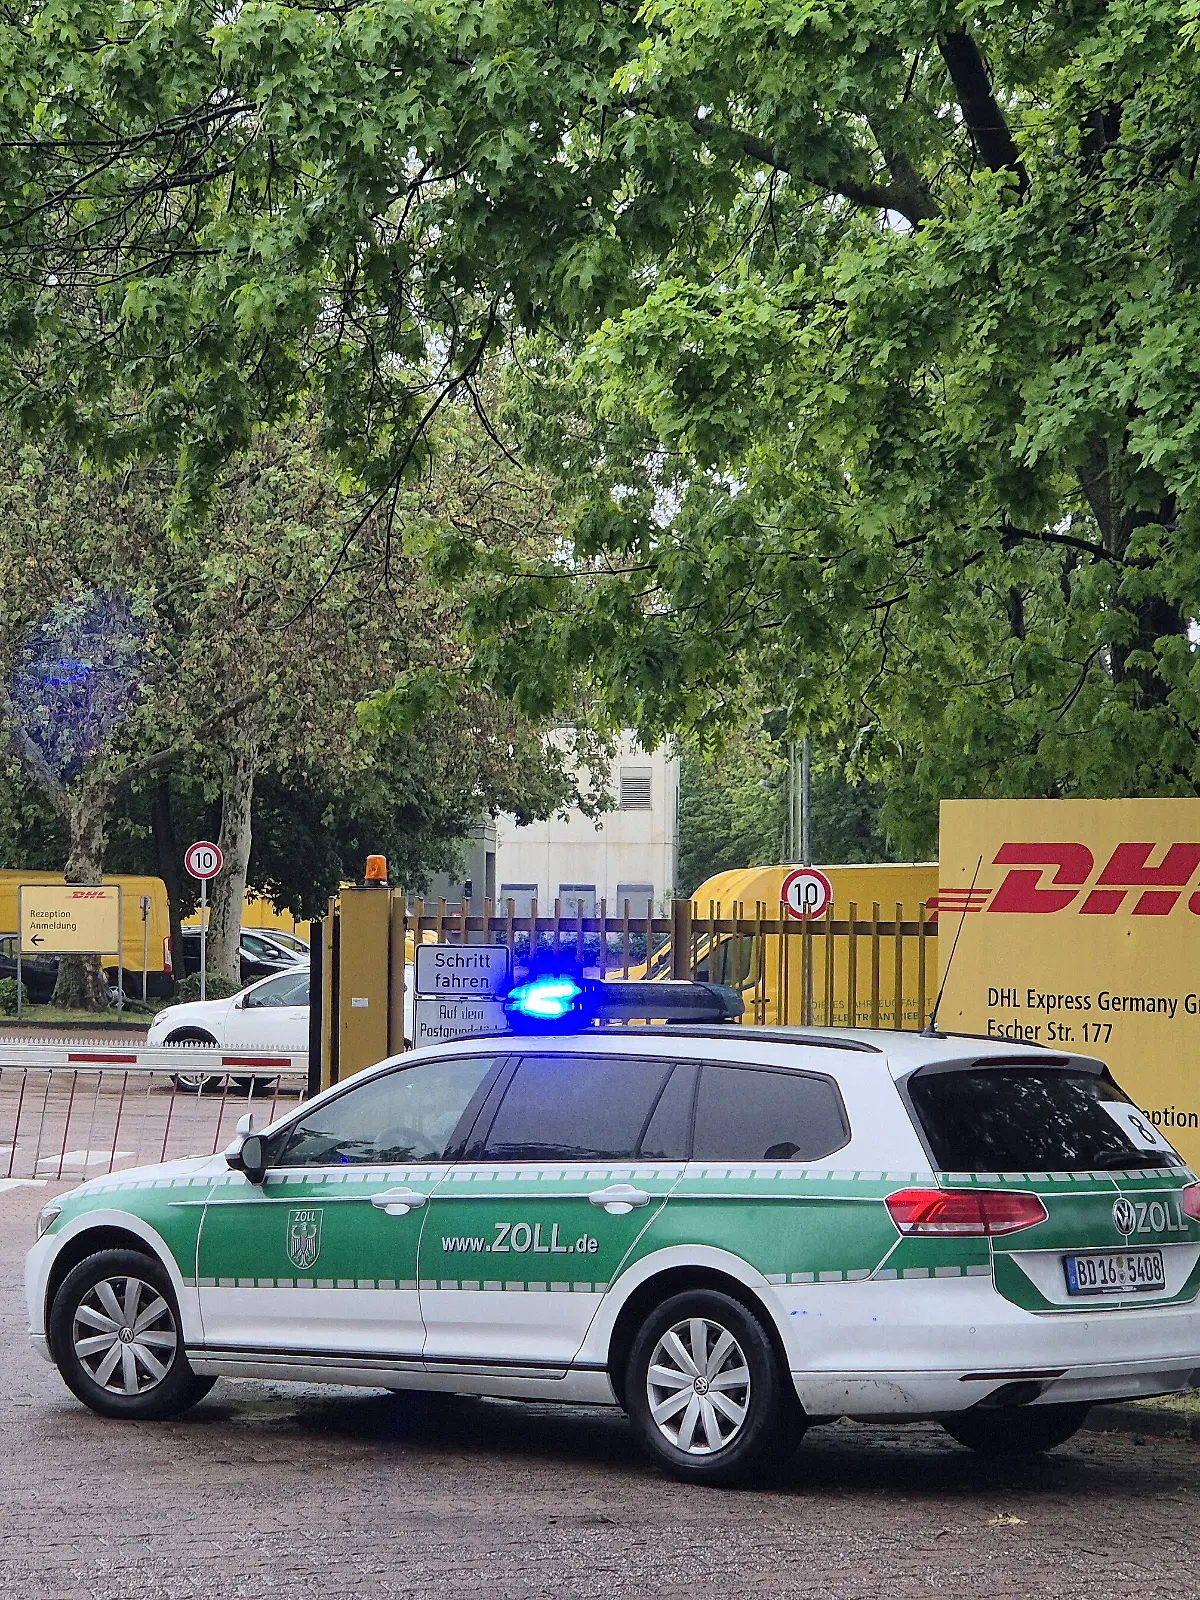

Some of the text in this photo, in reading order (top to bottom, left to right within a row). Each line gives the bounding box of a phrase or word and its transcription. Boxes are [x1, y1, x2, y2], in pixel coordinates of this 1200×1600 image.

[195, 852, 213, 869] 10
[986, 842, 1200, 916] DH
[71, 891, 107, 899] DHL
[794, 882, 818, 906] 10
[30, 909, 71, 919] Rezeption
[30, 921, 77, 932] Anmeldung
[434, 952, 491, 968] Schritt
[435, 973, 489, 989] fahren
[439, 1004, 484, 1020] Auf dem
[988, 987, 1200, 1019] DHL Express Germany G
[987, 1018, 1113, 1043] Escher Str. 177
[1127, 1114, 1157, 1145] 8
[294, 1211, 316, 1222] ZOLL
[1134, 1201, 1189, 1233] ZOLL
[441, 1222, 599, 1254] www.ZOLL.de
[1077, 1256, 1161, 1286] BD 16 5408
